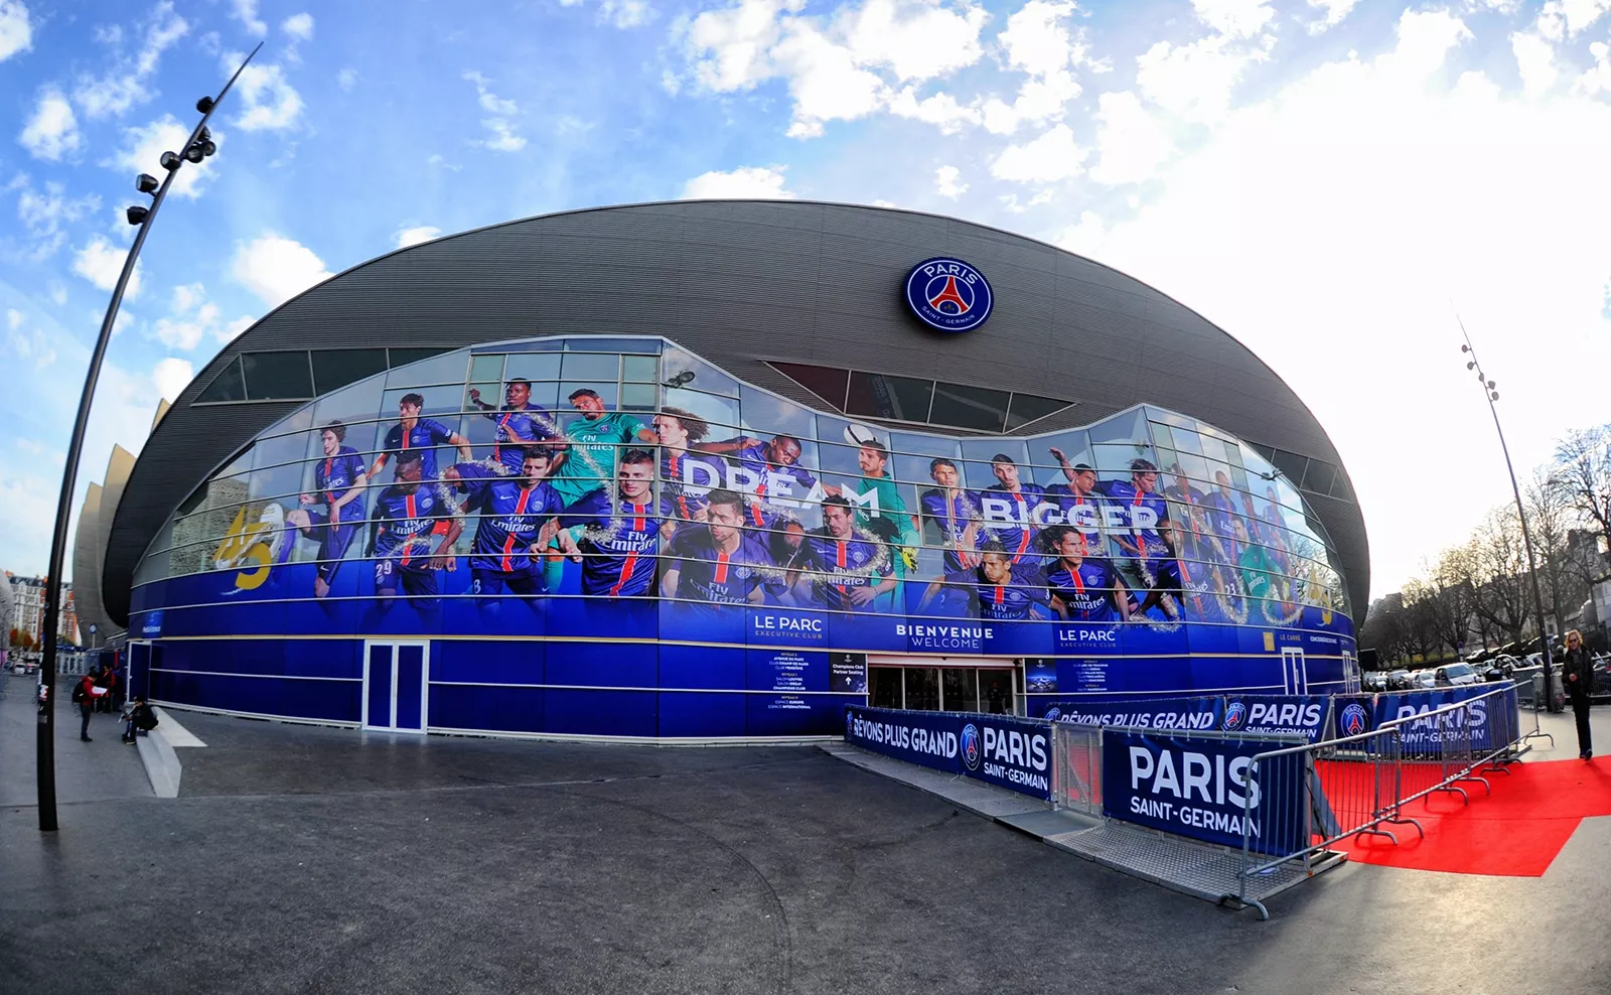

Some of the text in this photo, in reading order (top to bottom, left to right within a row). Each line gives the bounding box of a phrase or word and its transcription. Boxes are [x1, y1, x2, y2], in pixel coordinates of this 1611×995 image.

[923, 263, 979, 285] PARIS
[683, 458, 880, 518] DREAM
[981, 497, 1160, 536] BIGGER
[628, 531, 649, 542] Fly
[375, 561, 392, 577] 29
[708, 582, 729, 595] Fly
[755, 615, 822, 632] LE PARC
[896, 624, 994, 639] BIENVENUE
[755, 630, 823, 639] EXECUTIVE CLUB
[911, 637, 979, 649] WELCOME
[1059, 630, 1116, 641] LE PARC
[1112, 712, 1151, 728] PLUS
[1152, 712, 1214, 729] GRAND
[1248, 703, 1322, 727] PARIS
[1395, 700, 1487, 730] PARIS
[884, 724, 910, 749] PLUS
[911, 728, 958, 759] GRAND
[983, 727, 1047, 771] PARIS
[984, 762, 1048, 791] SAINT-GERMAIN
[1129, 746, 1262, 810] PARIS
[1130, 796, 1261, 839] SAINT-GERMAIN
